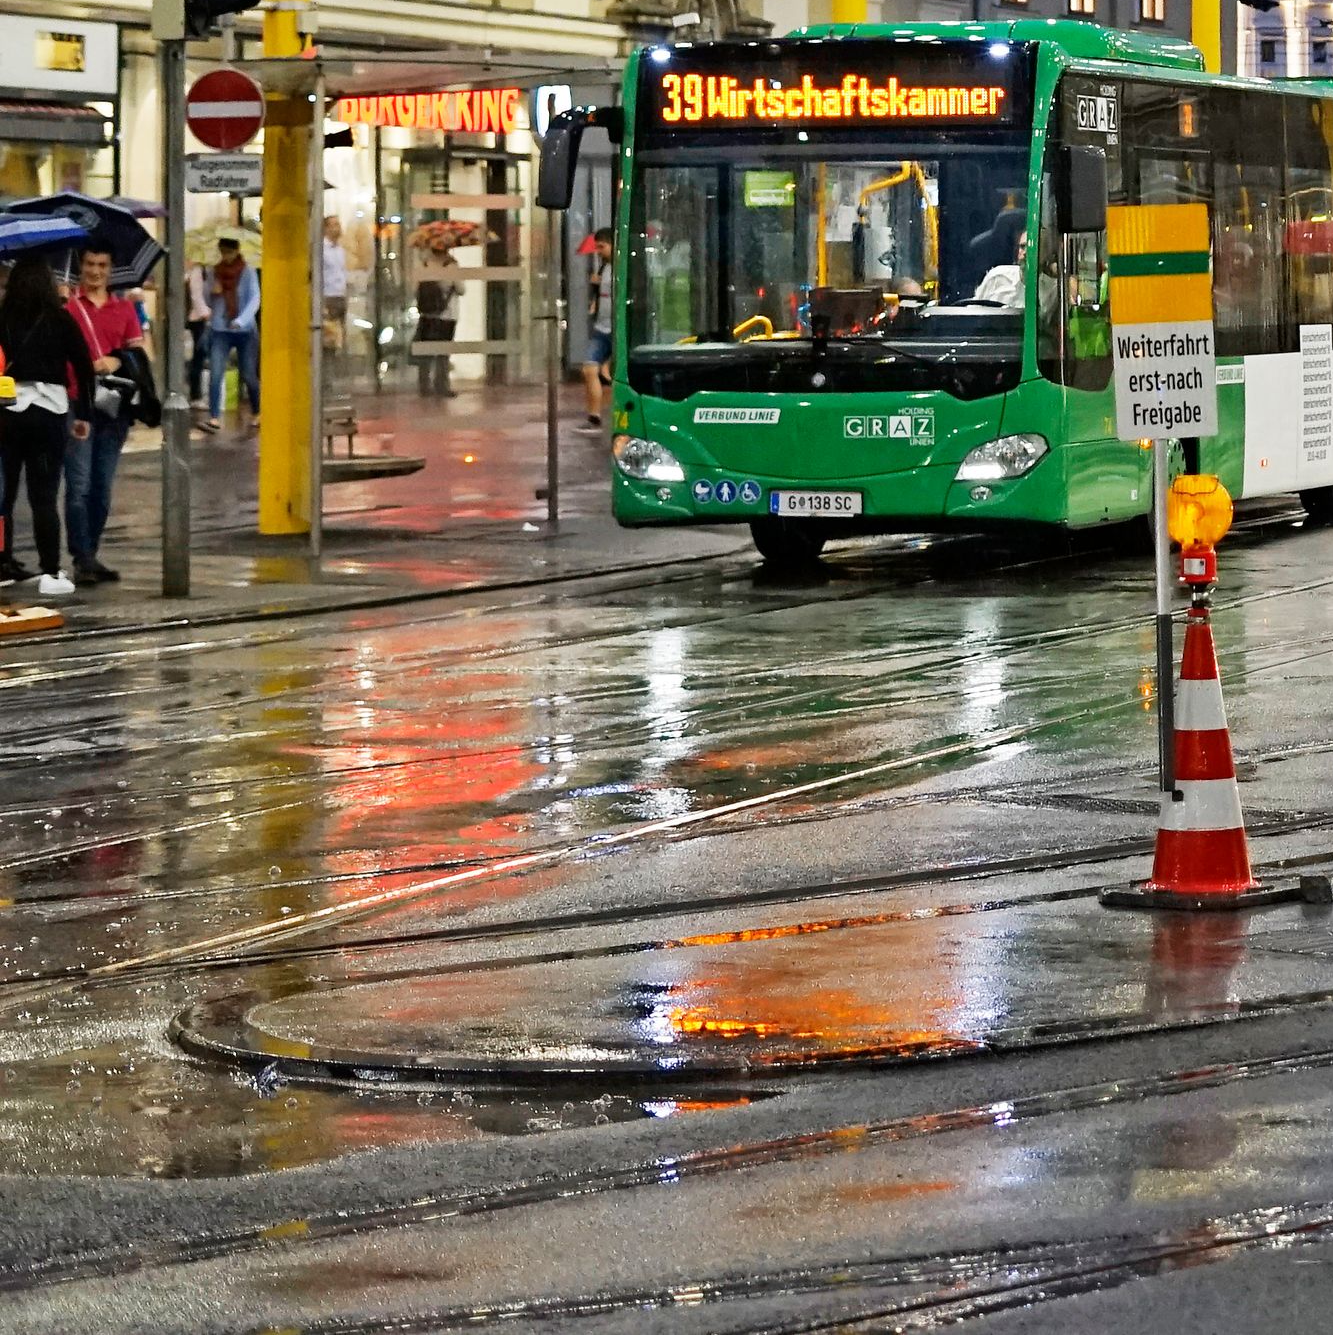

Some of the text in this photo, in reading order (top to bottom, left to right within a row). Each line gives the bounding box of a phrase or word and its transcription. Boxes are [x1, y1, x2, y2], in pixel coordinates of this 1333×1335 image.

[454, 88, 522, 134] KING
[661, 73, 1005, 122] 39 Wirtschaftskammer
[1077, 96, 1117, 131] GRAZ
[1117, 333, 1210, 359] Weiterfahrt
[698, 410, 776, 421] VERBUND LINIE
[845, 417, 933, 437] GRAZ
[1132, 401, 1202, 429] Freigabe
[788, 495, 852, 510] G 138 SC
